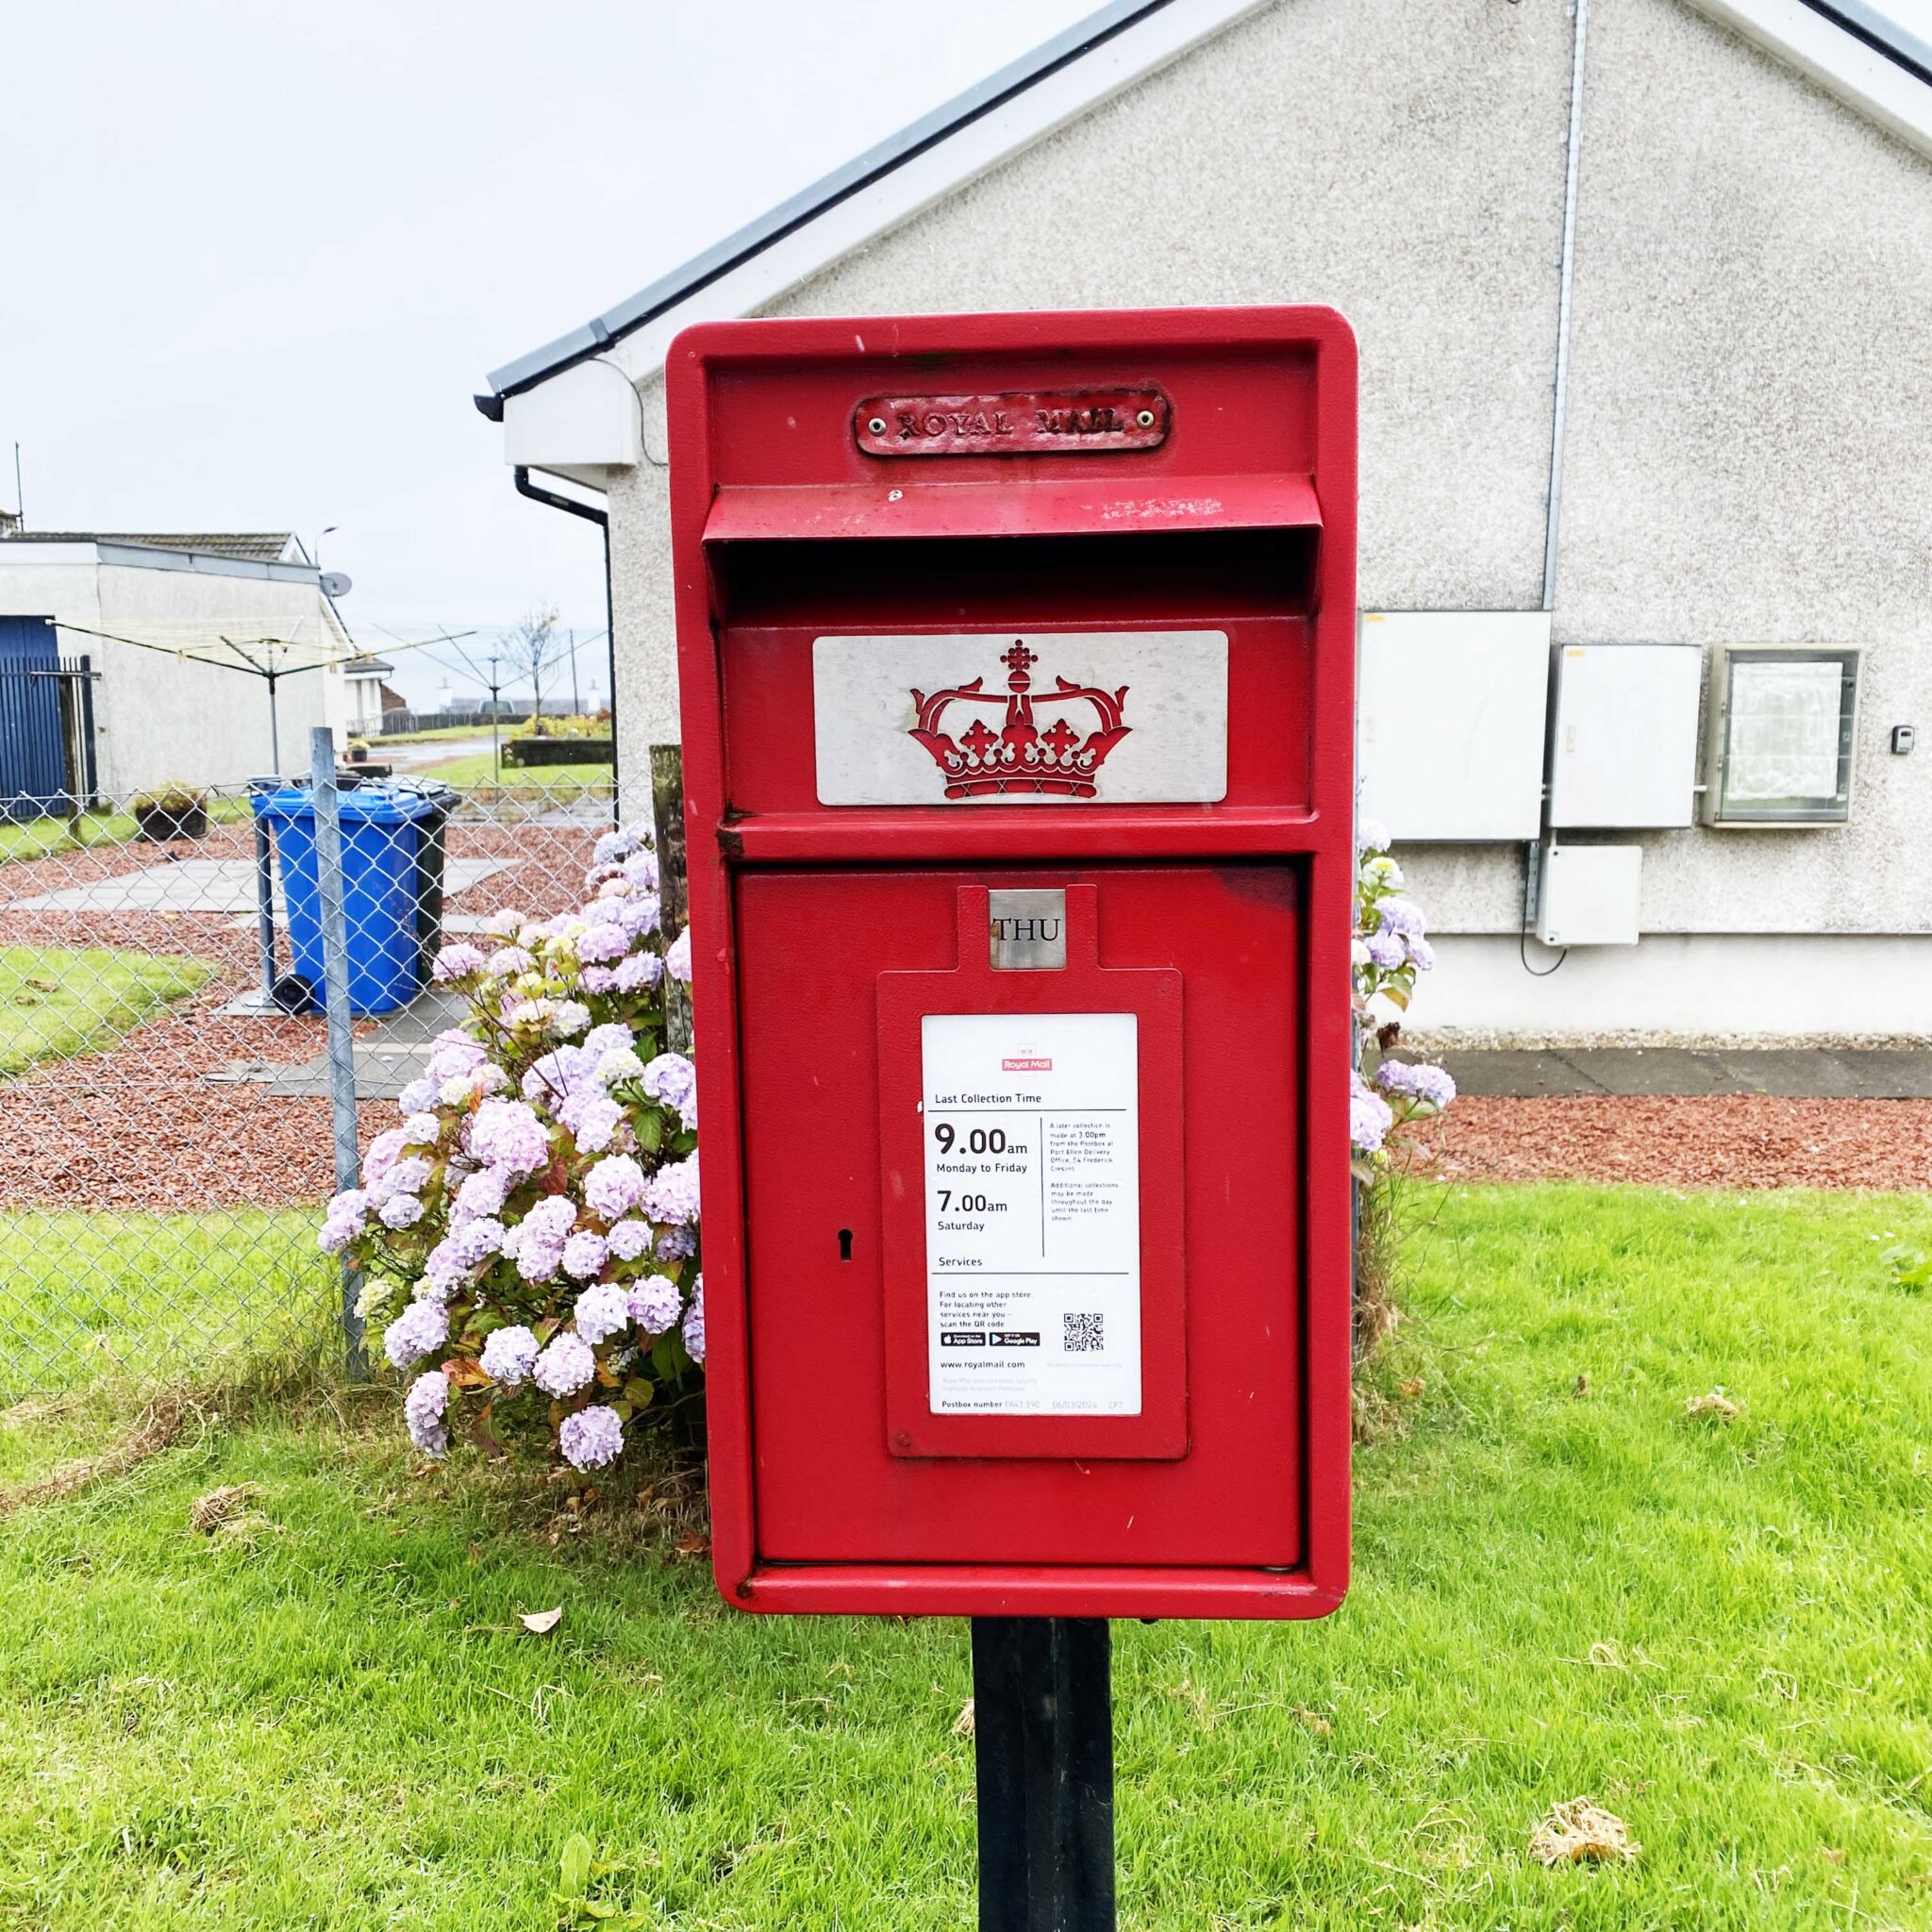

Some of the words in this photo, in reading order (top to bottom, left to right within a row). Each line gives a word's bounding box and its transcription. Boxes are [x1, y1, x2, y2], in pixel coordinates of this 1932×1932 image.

[895, 410, 1013, 440] ROYAL
[1036, 408, 1124, 434] MAIL
[992, 918, 1061, 941] THU
[1004, 1060, 1029, 1070] Royal
[1030, 1060, 1050, 1069] Mail
[935, 1093, 958, 1104] Last
[961, 1093, 1012, 1104] Collection
[1015, 1092, 1041, 1103] Time
[934, 1123, 1027, 1155] 9.00am
[936, 1163, 977, 1174] Monday
[980, 1164, 991, 1173] to
[995, 1162, 1027, 1174] Friday
[937, 1190, 1008, 1212] 7.00am
[938, 1221, 985, 1232] Saturday
[939, 1257, 983, 1267] Services
[954, 1301, 984, 1309] locating
[941, 1360, 1025, 1370] www.royalmail.com
